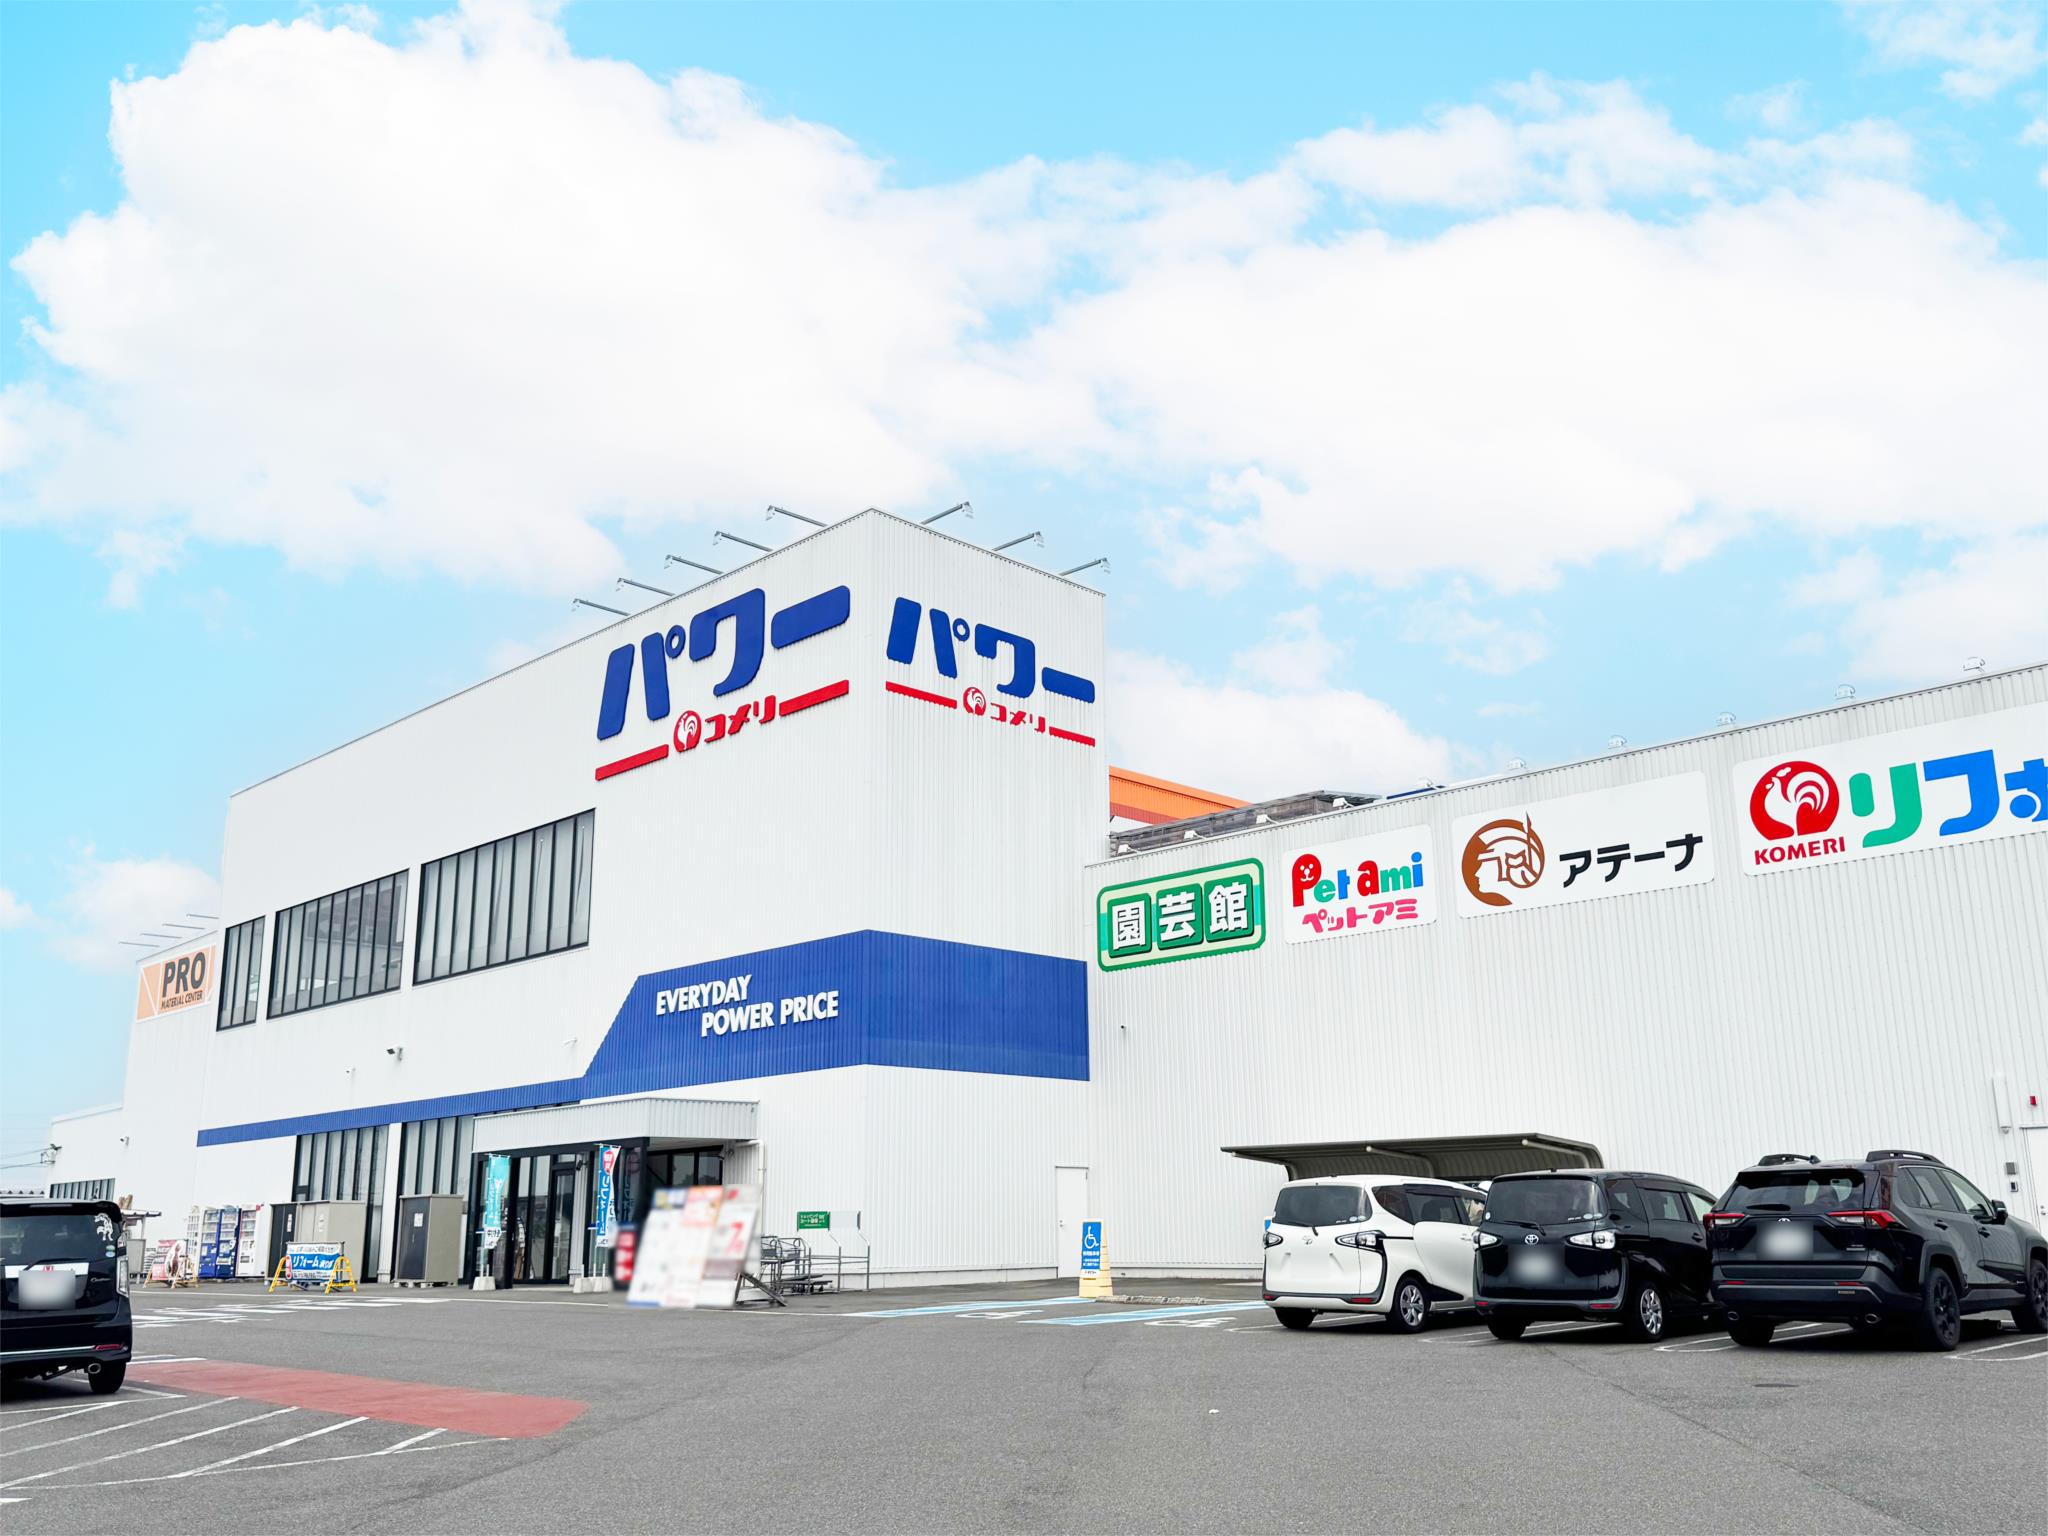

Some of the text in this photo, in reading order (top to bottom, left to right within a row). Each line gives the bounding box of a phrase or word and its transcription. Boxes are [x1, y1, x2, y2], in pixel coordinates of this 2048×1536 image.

[597, 586, 850, 740] パワー
[887, 597, 1095, 703] パワー
[704, 695, 776, 743] コメリ
[990, 702, 1046, 733] コメリ
[1559, 833, 1703, 888] アテーナ
[1754, 836, 1845, 865] KOMERI
[1112, 882, 1248, 951] 園芸館
[1302, 898, 1418, 933] ペットアミ
[162, 952, 206, 997] PRO
[656, 974, 752, 1016] EVERYDAY
[161, 990, 203, 1009] MATERIAL CENTER
[701, 990, 839, 1037] POWER PRICE
